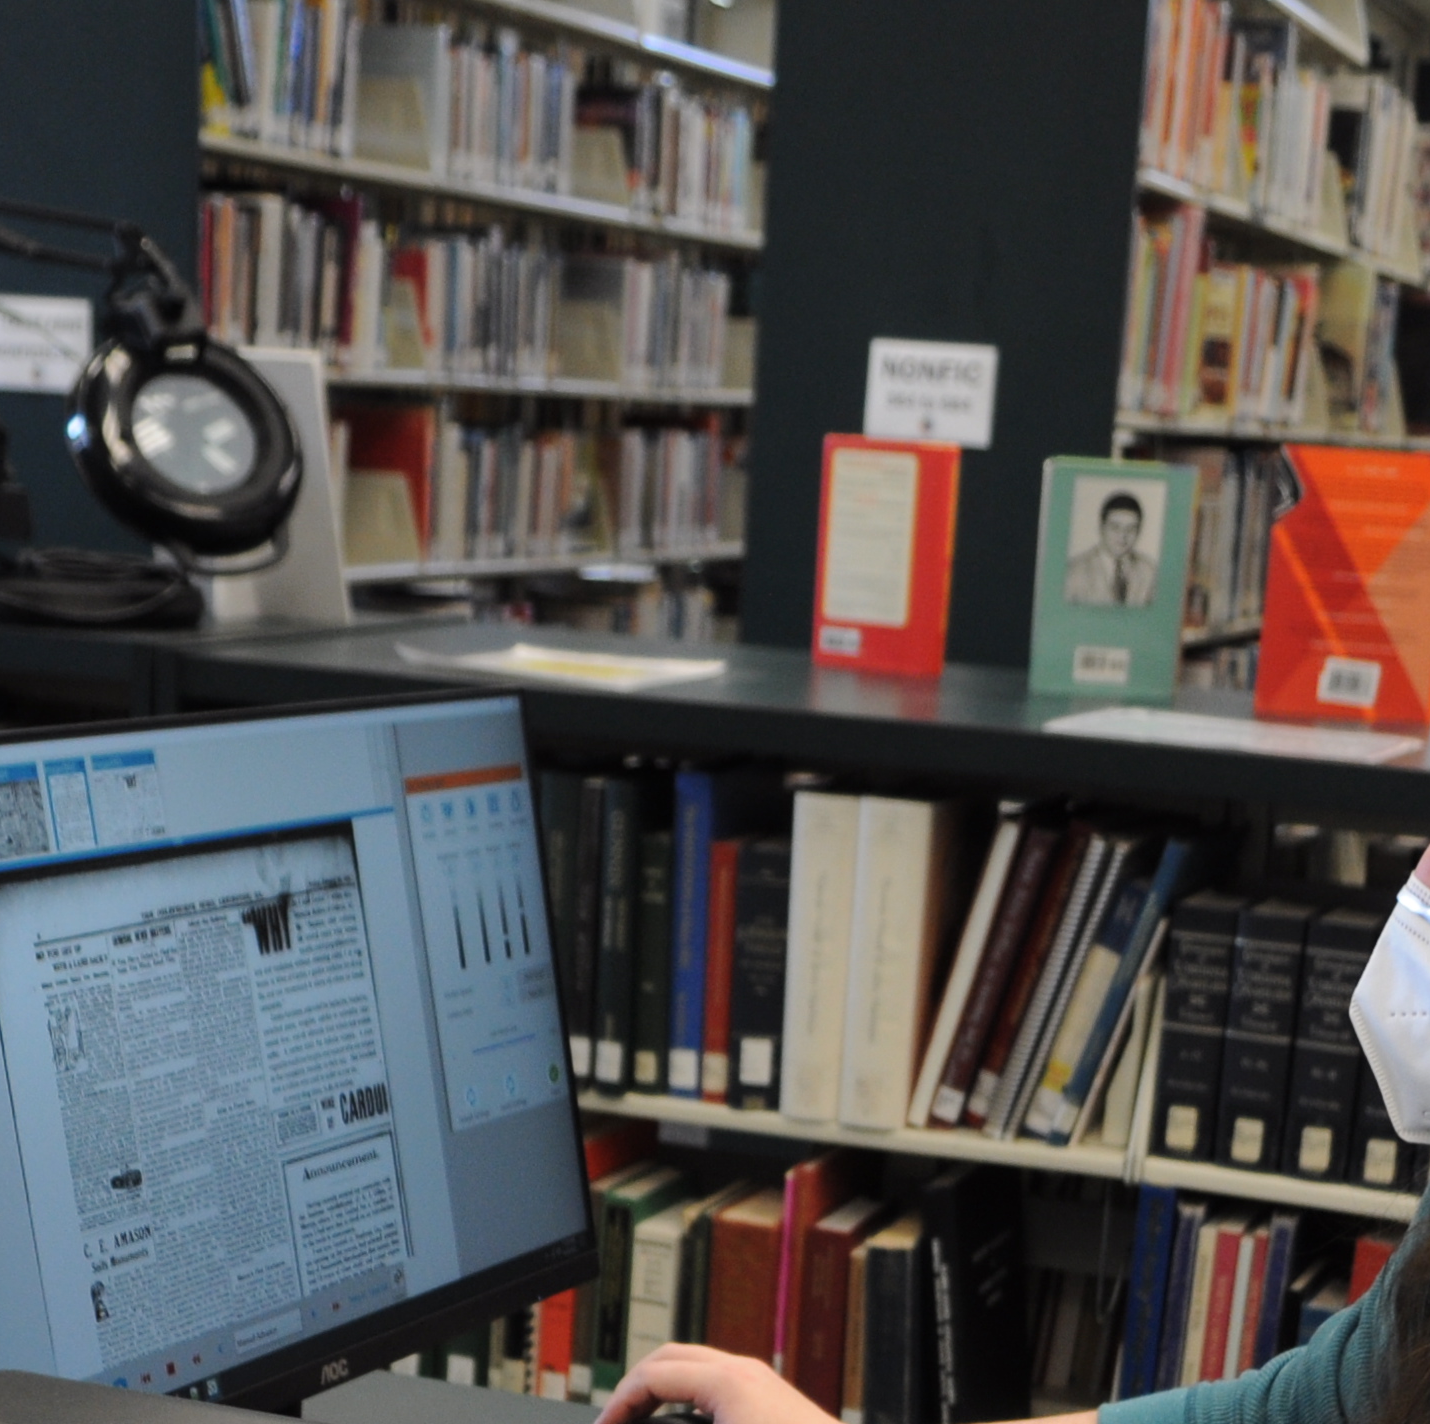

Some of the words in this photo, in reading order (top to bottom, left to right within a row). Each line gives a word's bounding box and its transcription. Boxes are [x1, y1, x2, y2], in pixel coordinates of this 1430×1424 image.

[339, 1082, 388, 1126] CARDUI
[114, 1224, 152, 1249] AMASON
[321, 1358, 350, 1386] AOC
